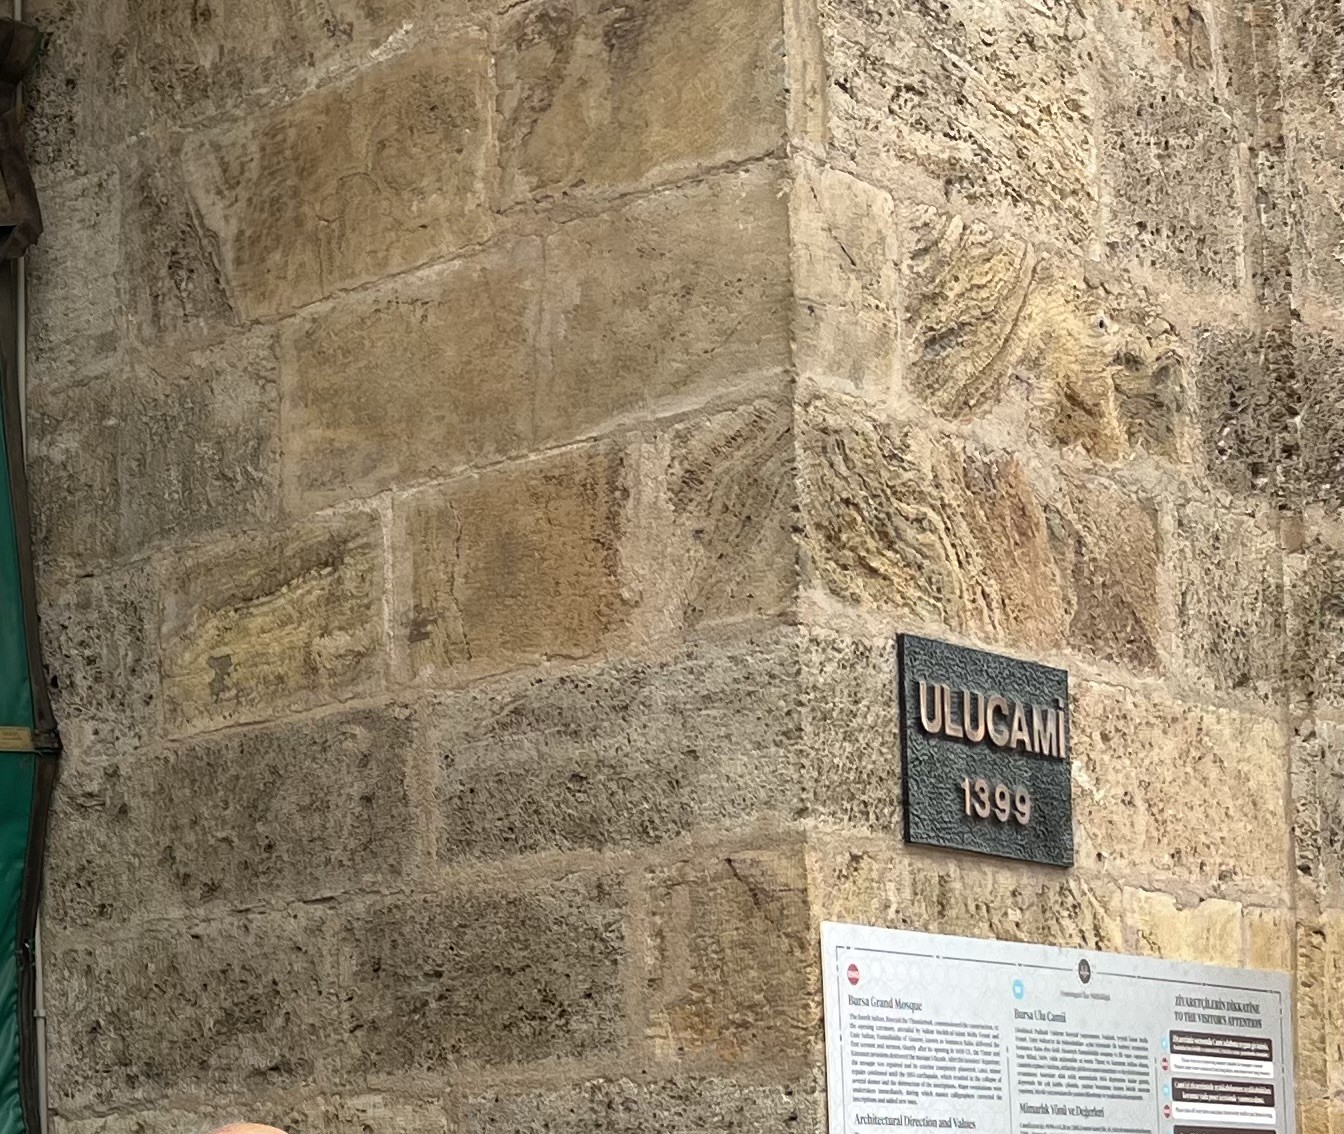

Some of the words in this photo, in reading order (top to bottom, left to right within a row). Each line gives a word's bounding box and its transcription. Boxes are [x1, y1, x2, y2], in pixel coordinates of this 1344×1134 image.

[919, 680, 1066, 758] ULUCAMİ
[961, 777, 1031, 825] 1399
[938, 1117, 952, 1129] and
